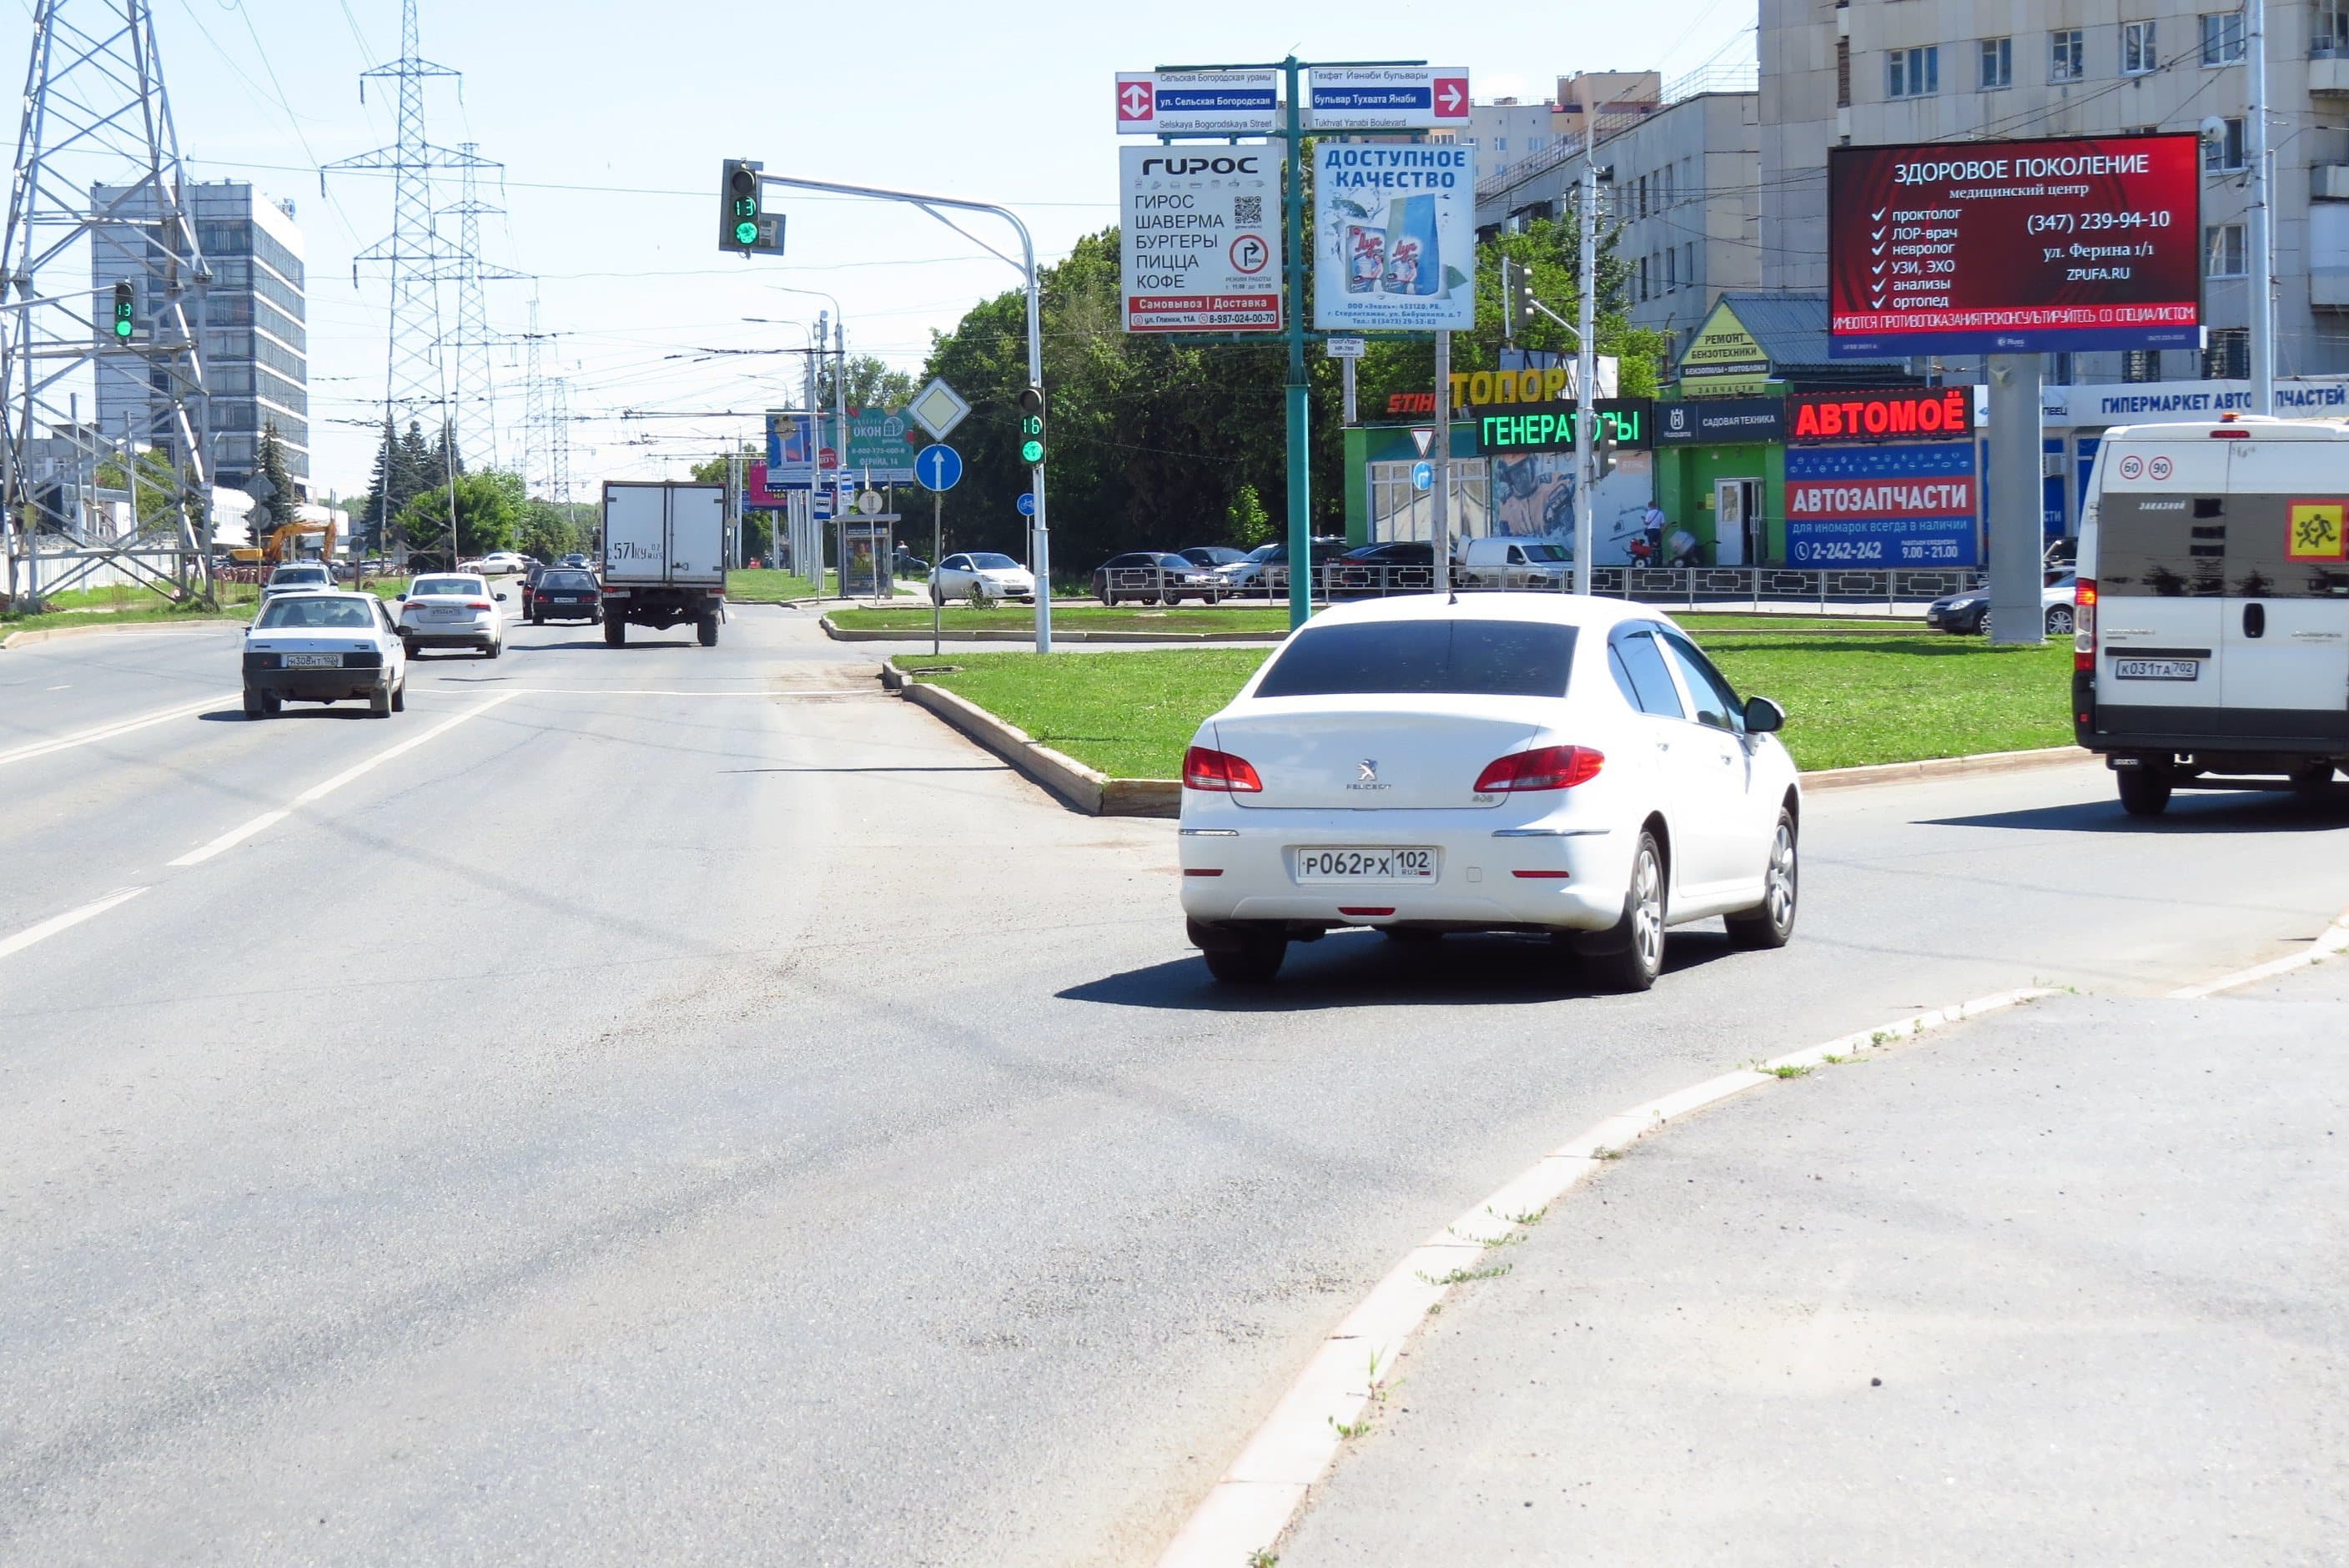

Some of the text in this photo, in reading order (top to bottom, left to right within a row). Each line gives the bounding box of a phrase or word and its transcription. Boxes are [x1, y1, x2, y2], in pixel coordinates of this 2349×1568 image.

[1160, 73, 1271, 83] Сельская Богородская урамы
[1383, 71, 1428, 81] бульвары
[1160, 96, 1270, 108] ул. Сельская Богородская
[1315, 93, 1416, 106] бульвар Тухвата Янаби
[1159, 119, 1272, 129] Selskaya Bogorodskaya Street
[1371, 118, 1406, 127] Boulevard
[1325, 149, 1466, 169] ДОСТУПНОЕ
[1894, 154, 2149, 186] ЗДОРОВОЕ ПОКОЛЕНИЕ
[1335, 171, 1455, 188] КАЧЕСТВО
[1949, 183, 2090, 199] медицинский центр
[736, 199, 754, 216] 13
[1134, 194, 1195, 209] ГИРОС
[1135, 214, 1225, 229] ШАВЕРМА
[1892, 209, 1962, 224] проктолог
[2027, 210, 2170, 235] (347) 239-94-10
[1892, 227, 1958, 241] ЛОР-врач
[1136, 234, 1218, 249] БУРГЕРЫ
[1892, 244, 1955, 257] невролог
[2043, 241, 2154, 262] ул. Ферина 1/1
[1136, 254, 1199, 271] ПИЦЦА
[1891, 259, 1955, 275] УЗИ, ЭХО
[2066, 267, 2130, 281] ZPUFA.RU
[1137, 274, 1185, 289] КОФЕ
[1894, 279, 1950, 291] анализы
[1139, 298, 1267, 309] Самовывоз Доставка
[1893, 296, 1949, 309] ортопед
[118, 303, 132, 317] 13
[2099, 309, 2112, 322] СО
[2115, 306, 2195, 323] СПЕЦИАЛИСТОМ
[1210, 314, 1275, 324] 8-987-024-00-70
[1705, 333, 1744, 344] РЕМОНТ
[1691, 347, 1757, 359] БЕНЗОТЕХНИКИ
[1685, 364, 1767, 375] БЕНЗОПИЛЫ МОТОБЛОКИ
[1450, 368, 1568, 409] ТОПОР
[1698, 384, 1754, 394] ЗАПЧАСТИ
[1386, 393, 1436, 414] STIH
[2101, 384, 2345, 414] ГИПЕРМАРКЕТ АВТОПЧАСТЕЙ
[1796, 390, 1964, 435] АВТОМОЁ
[1024, 417, 1040, 435] 16
[1482, 410, 1639, 446] ГЕНЕРАЫ
[1703, 415, 1775, 428] САДОВАЯ ТЕХНИКА
[854, 426, 881, 437] ОКОН
[2124, 462, 2139, 473] 60
[2153, 463, 2168, 474] 90
[1793, 485, 1967, 512] АВТОЗАПЧАСТИ
[2138, 500, 2186, 510] ЗАКАЗНОЙ
[1793, 520, 1967, 535] для иномарок всегда в наличии
[1813, 542, 1882, 560] 2-242-242
[1902, 546, 1923, 558] 9.00
[1931, 546, 1958, 558] 21.00
[1471, 793, 1494, 802] 408
[1305, 851, 1428, 875] Р062РХ 102
